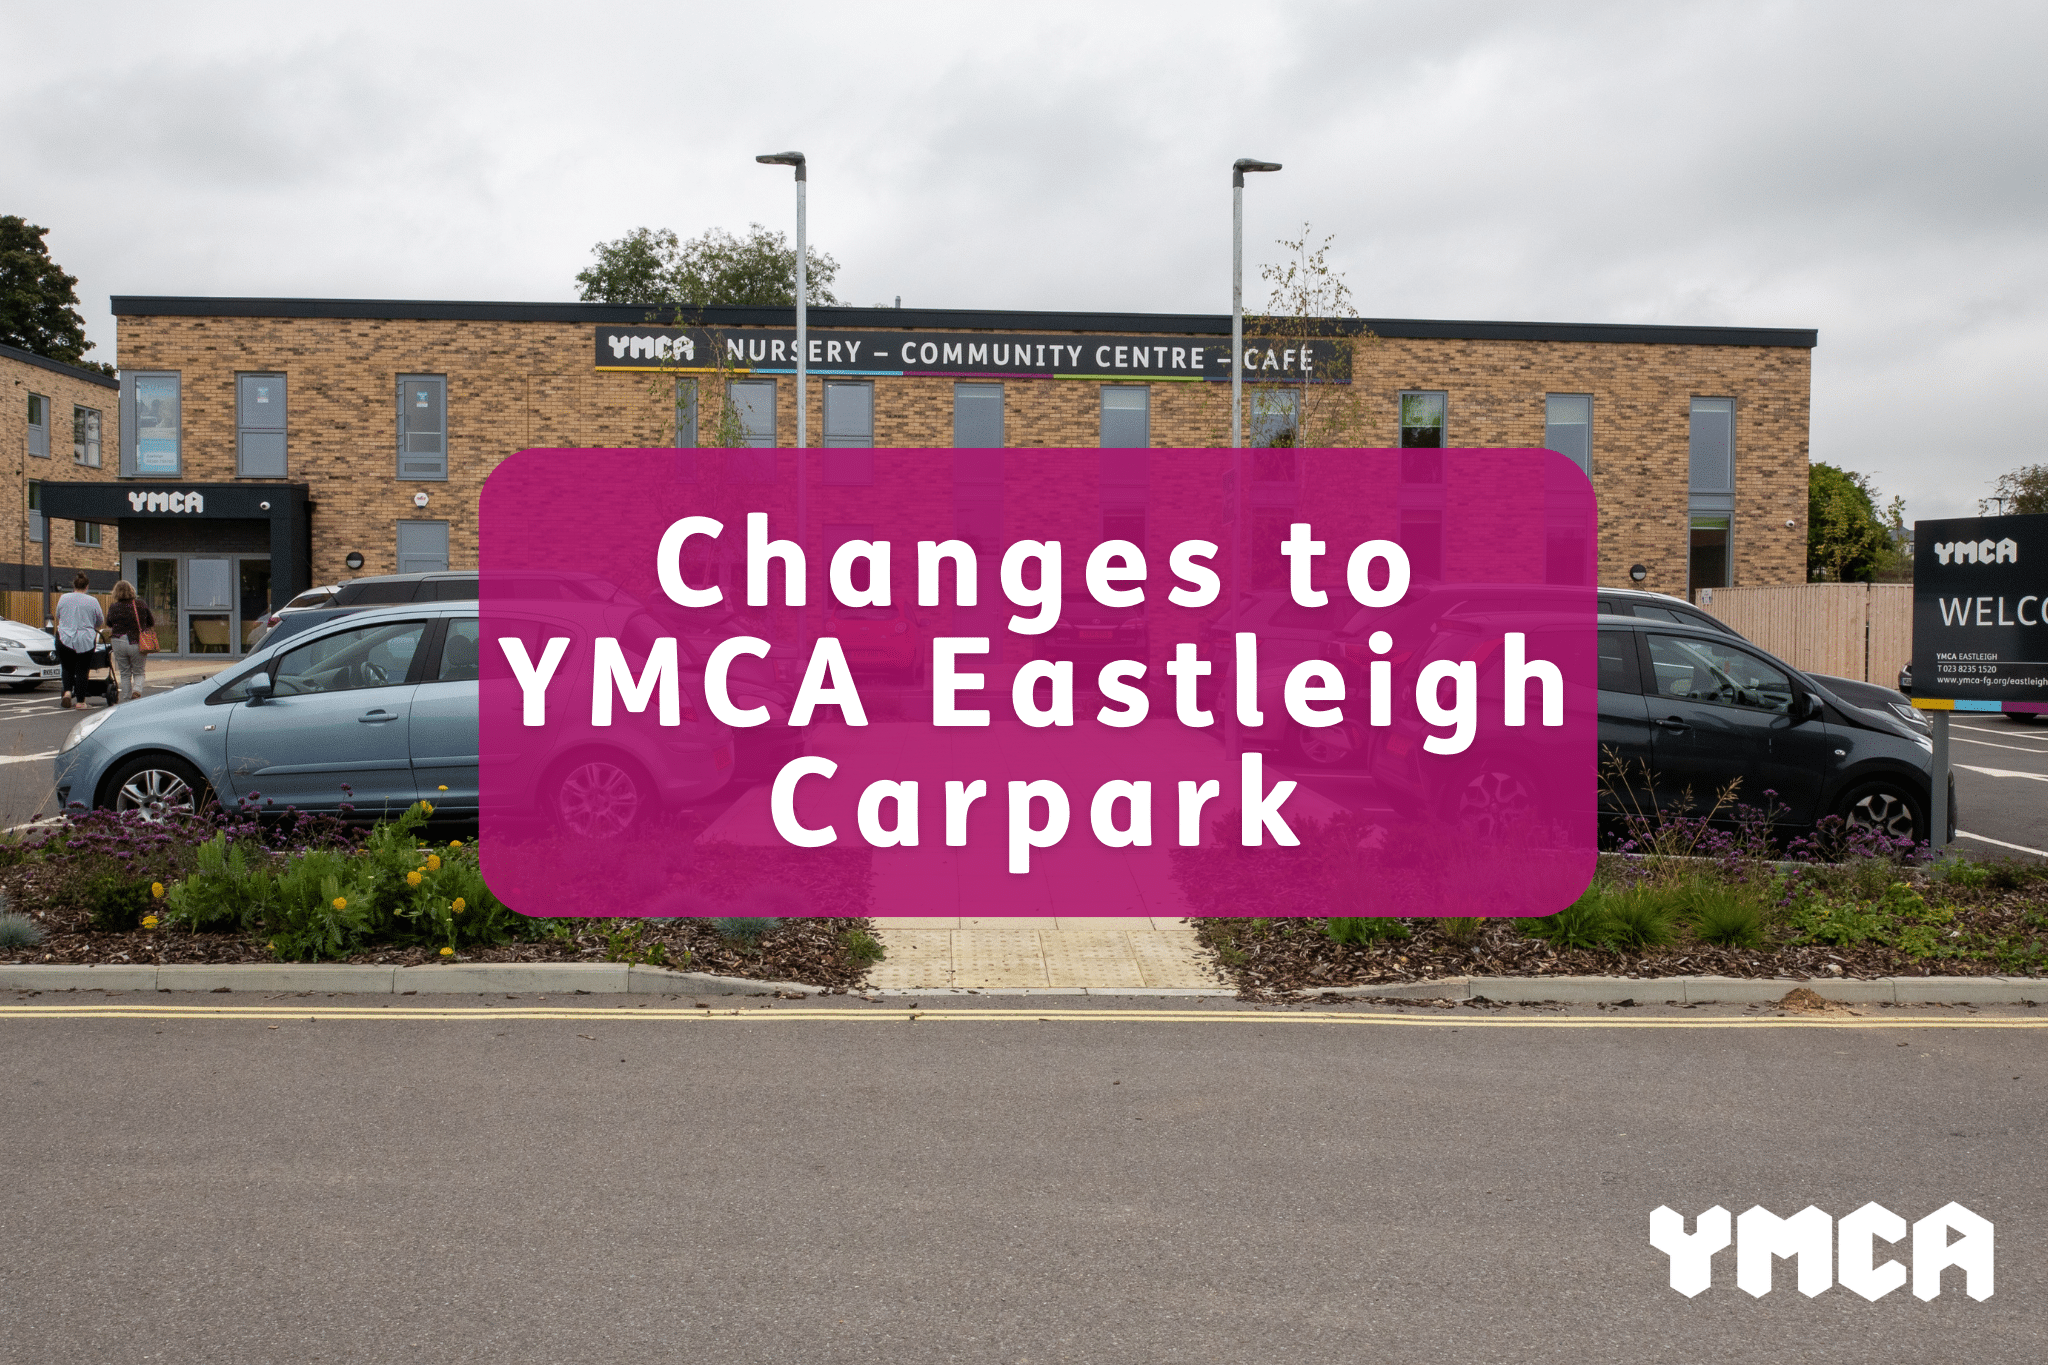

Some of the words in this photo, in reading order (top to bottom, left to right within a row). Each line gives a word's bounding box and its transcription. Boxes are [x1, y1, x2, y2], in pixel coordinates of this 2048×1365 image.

[608, 335, 695, 361] YMCA
[727, 338, 861, 362] NURSERY
[901, 341, 1083, 367] COMMUNITY
[1095, 345, 1205, 370] CENTRE
[128, 491, 204, 514] YMCA
[1934, 537, 2018, 566] YMCA
[1938, 595, 2048, 627] WELC
[1936, 652, 1957, 661] YMCA
[1958, 652, 1998, 661] EASTLEIGH
[1937, 664, 1942, 673] T
[1942, 664, 1957, 673] 023
[1957, 664, 1977, 673] 8235
[1978, 665, 1997, 674] 1520
